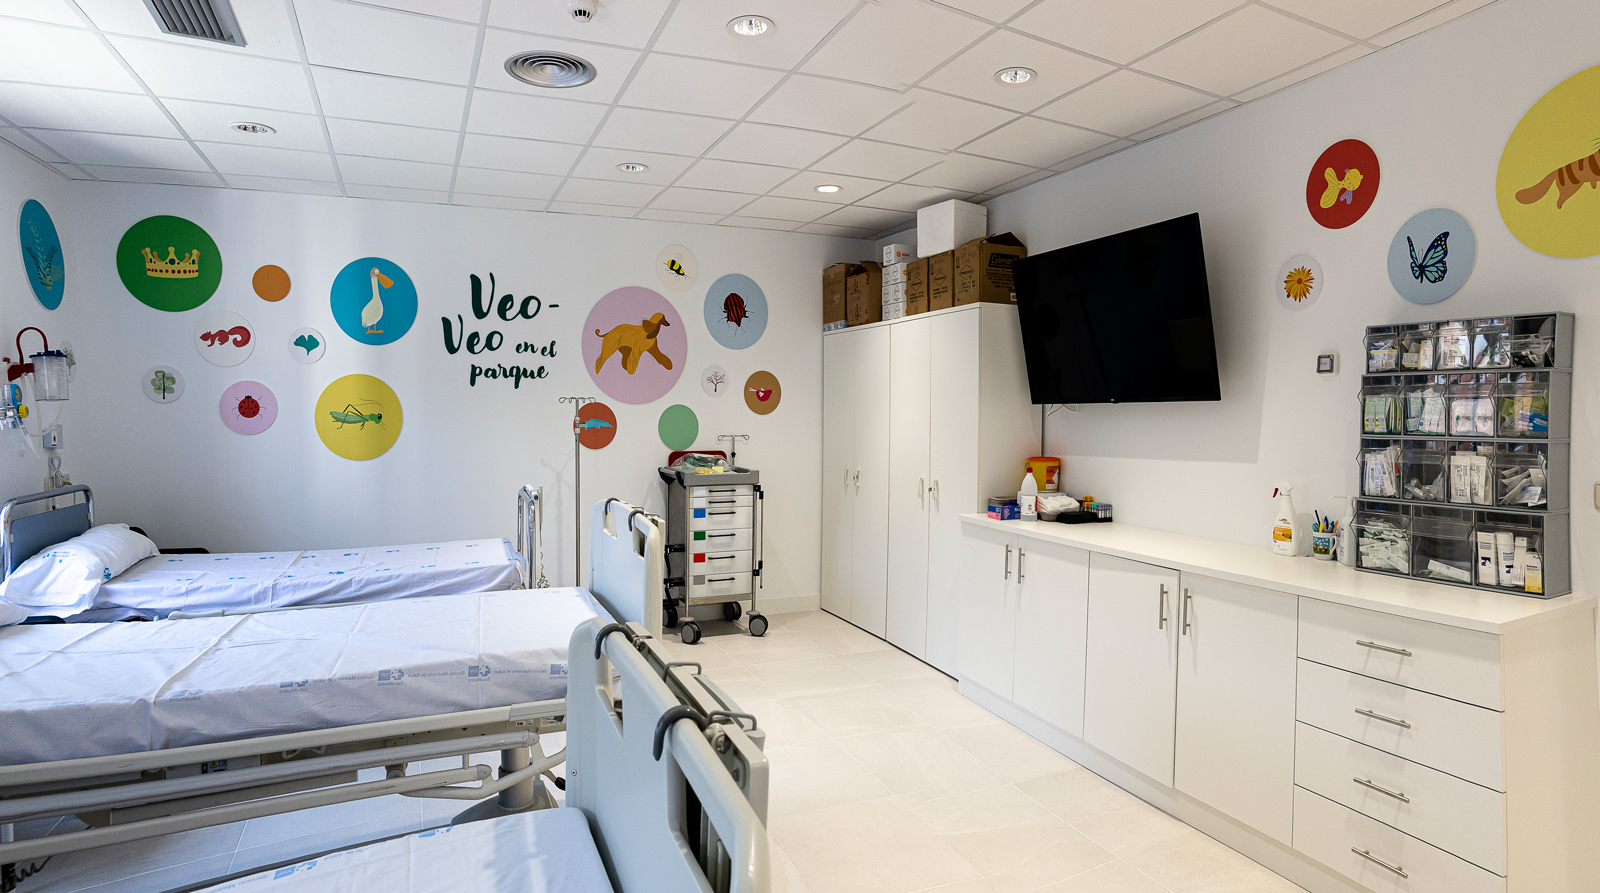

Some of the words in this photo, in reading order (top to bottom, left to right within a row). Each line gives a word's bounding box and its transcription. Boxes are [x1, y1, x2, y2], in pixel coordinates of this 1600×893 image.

[441, 314, 504, 355] Veo
[515, 341, 539, 354] en
[540, 340, 558, 358] el
[469, 363, 549, 390] parque
